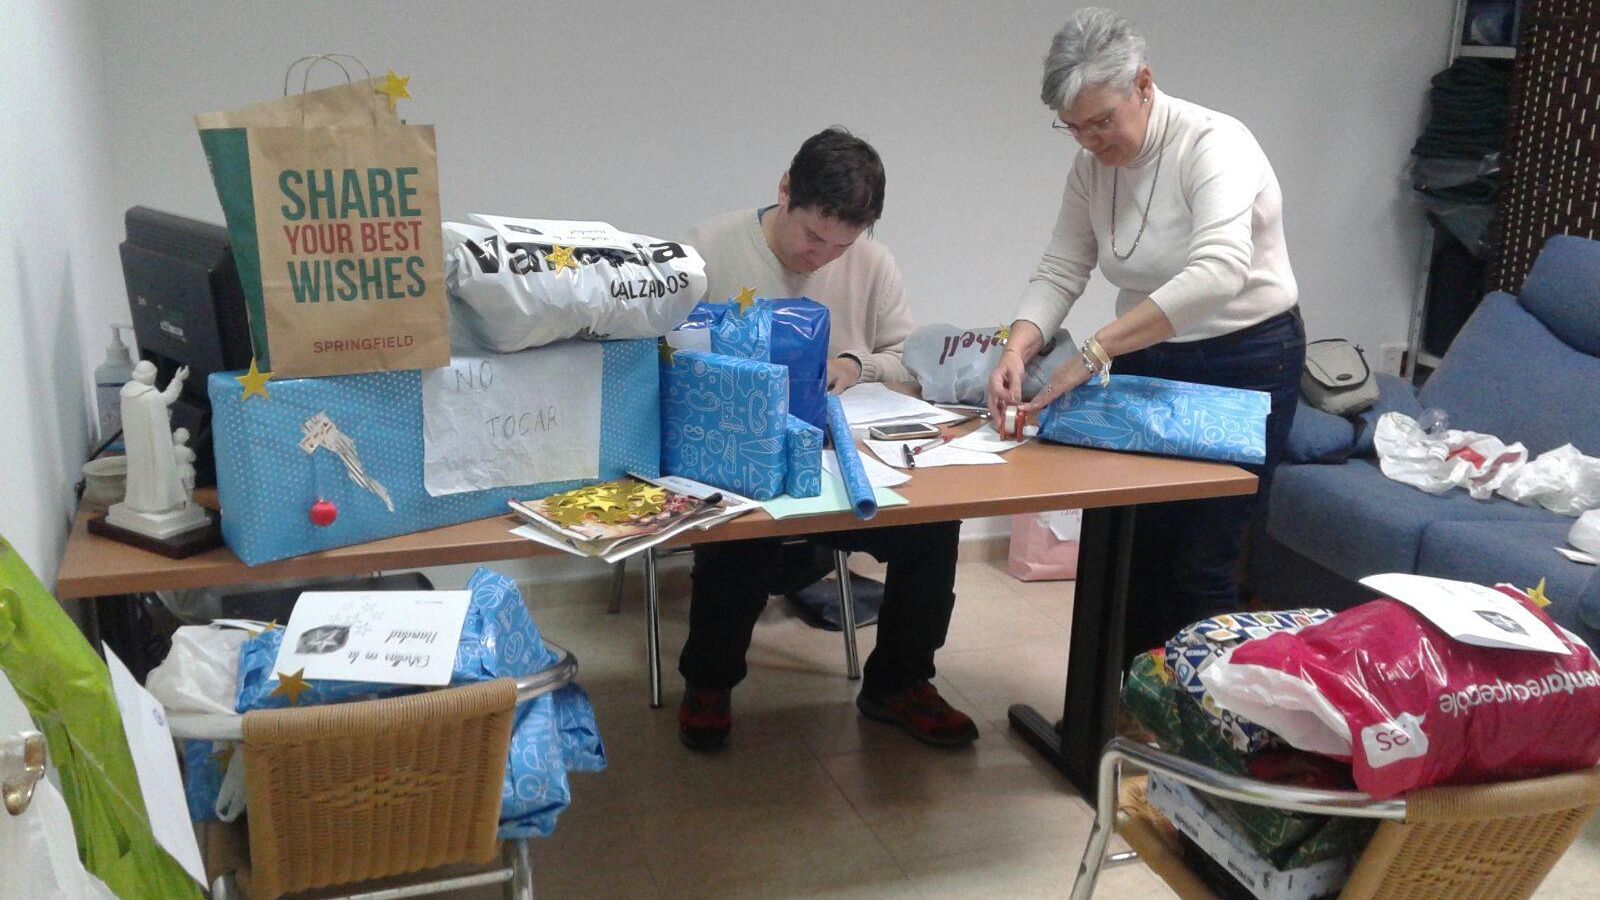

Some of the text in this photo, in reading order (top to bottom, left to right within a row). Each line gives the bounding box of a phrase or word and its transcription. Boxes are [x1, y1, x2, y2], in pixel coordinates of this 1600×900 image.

[278, 167, 422, 221] SHARE
[283, 221, 423, 255] YOUR BEST
[287, 255, 426, 304] WISHES
[610, 271, 690, 301] CALZADOS
[313, 335, 414, 354] SPRINGFIELD
[454, 359, 495, 392] NO
[485, 405, 560, 438] TOCAR
